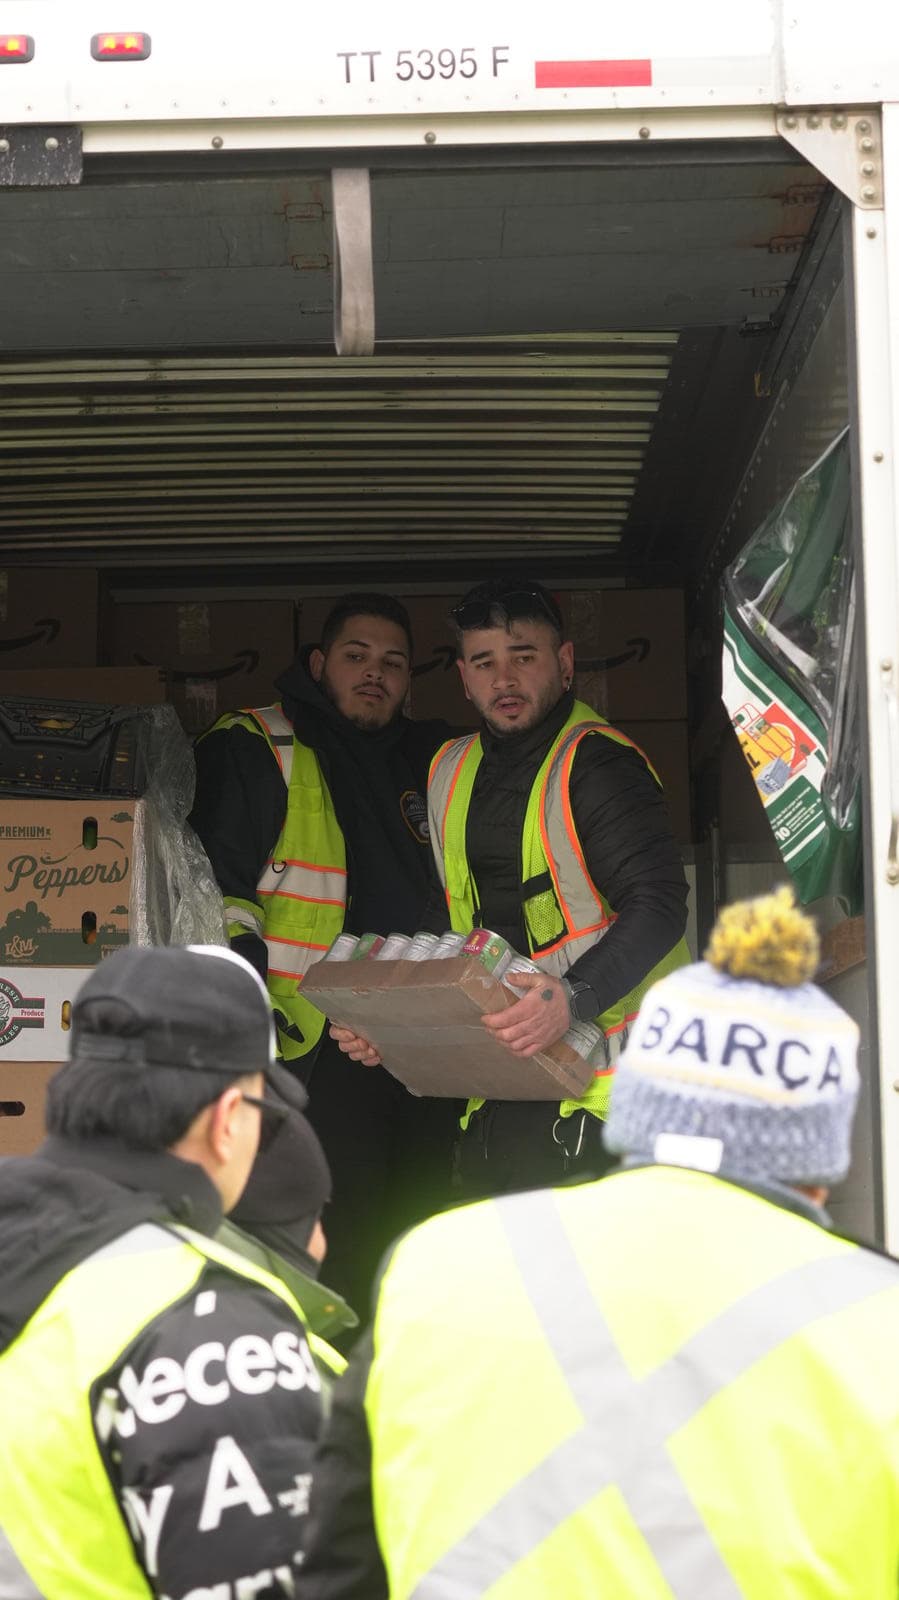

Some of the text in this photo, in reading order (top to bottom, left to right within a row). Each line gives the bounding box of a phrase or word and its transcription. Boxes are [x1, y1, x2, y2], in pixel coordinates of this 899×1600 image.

[337, 46, 510, 83] TT 5395 F
[0, 825, 45, 838] PREMIUM
[4, 855, 129, 899] Peppers
